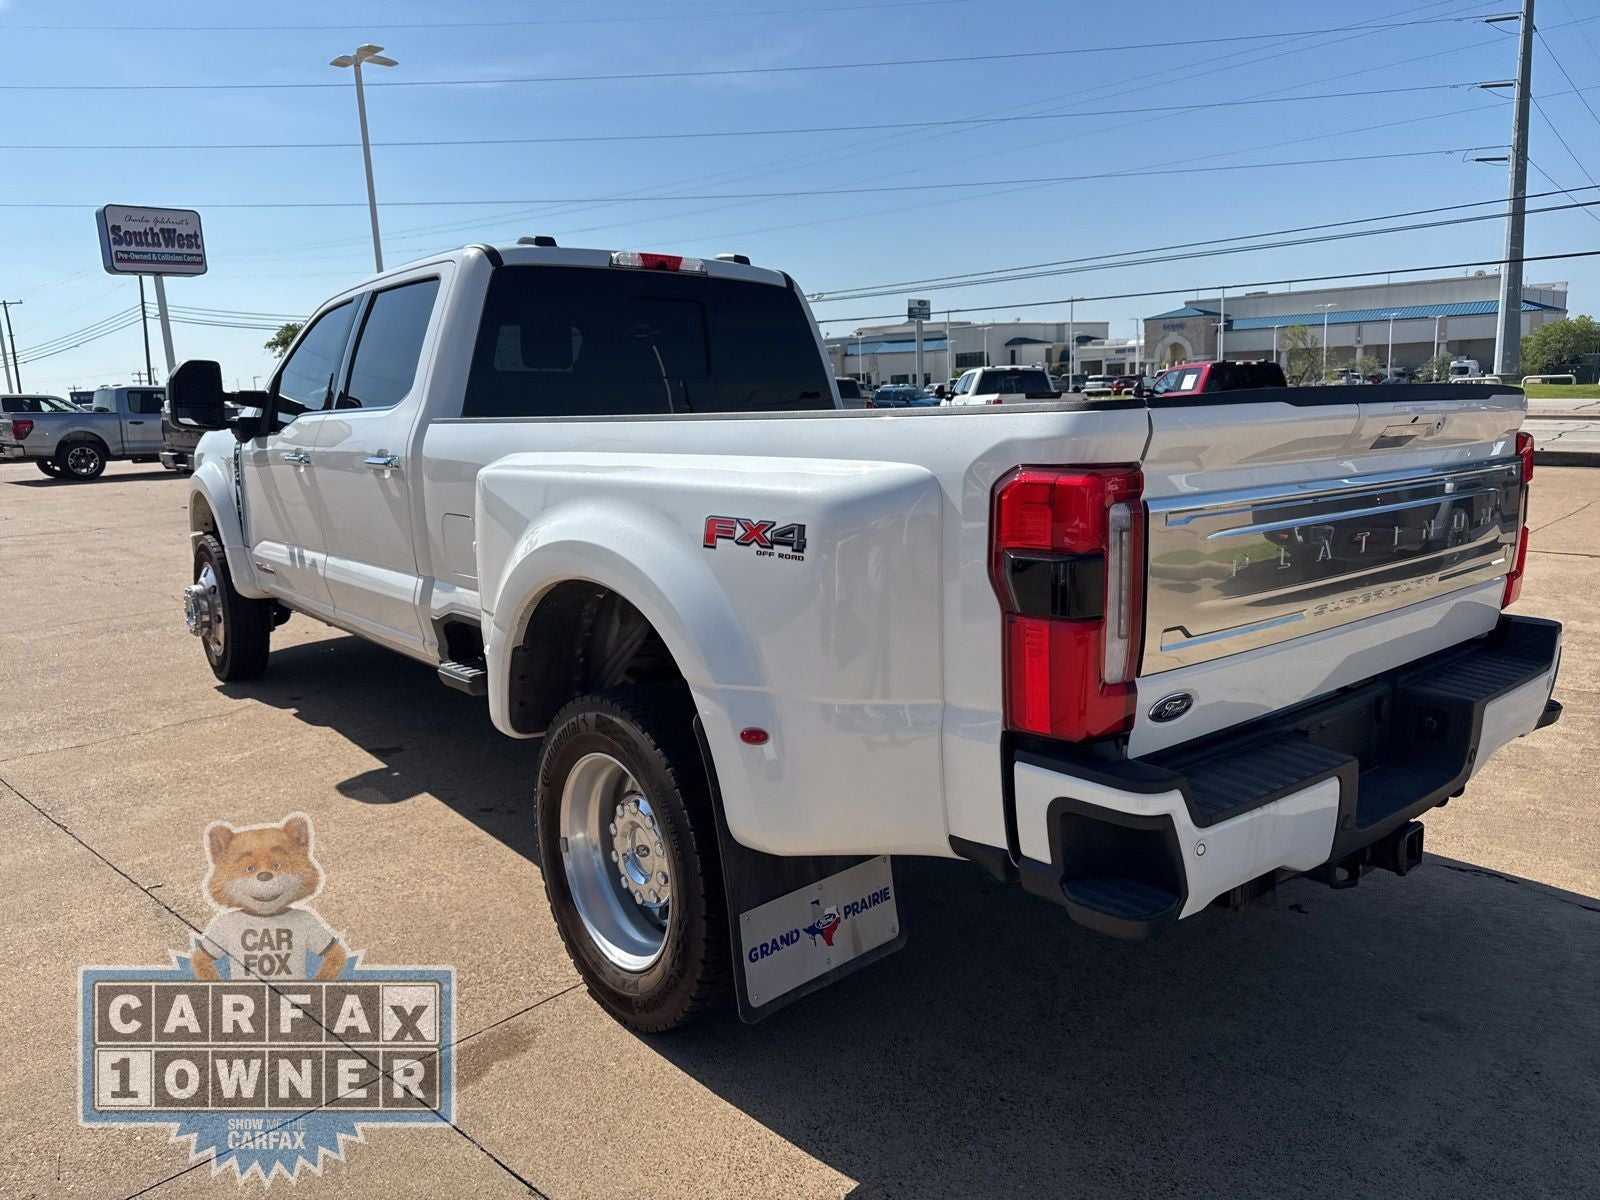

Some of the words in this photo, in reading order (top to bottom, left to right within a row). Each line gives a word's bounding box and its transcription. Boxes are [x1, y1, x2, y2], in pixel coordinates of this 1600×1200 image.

[110, 224, 200, 249] SouthWest
[117, 252, 151, 261] Pre-Owned
[157, 253, 183, 262] Collision
[703, 515, 807, 553] FX4
[1233, 507, 1492, 577] PLATINUM
[756, 550, 775, 558] OFF
[778, 552, 805, 562] ROAD
[541, 715, 581, 787] Continental
[748, 928, 800, 963] GRAND
[843, 886, 891, 919] PRAIRIE
